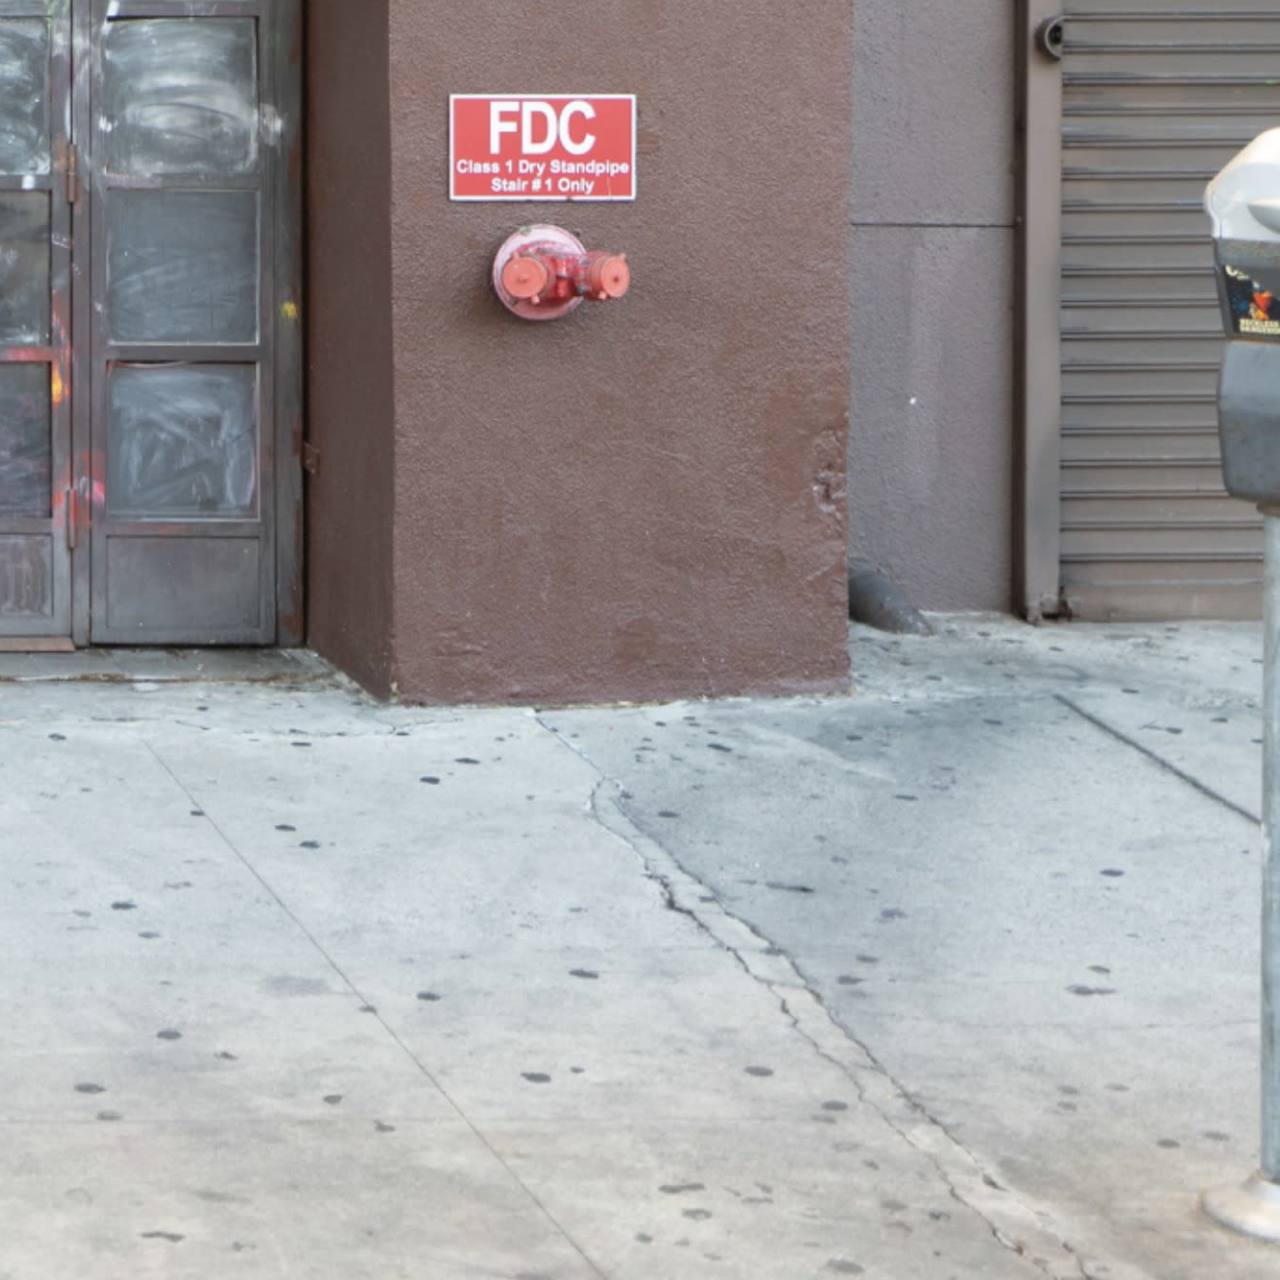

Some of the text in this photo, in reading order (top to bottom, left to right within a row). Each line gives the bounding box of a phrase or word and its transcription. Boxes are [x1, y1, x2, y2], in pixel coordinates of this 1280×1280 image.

[490, 100, 596, 155] FDC
[456, 159, 630, 177] Class 1 Dry Standpipe
[491, 177, 528, 192] Stair
[557, 178, 594, 194] Only
